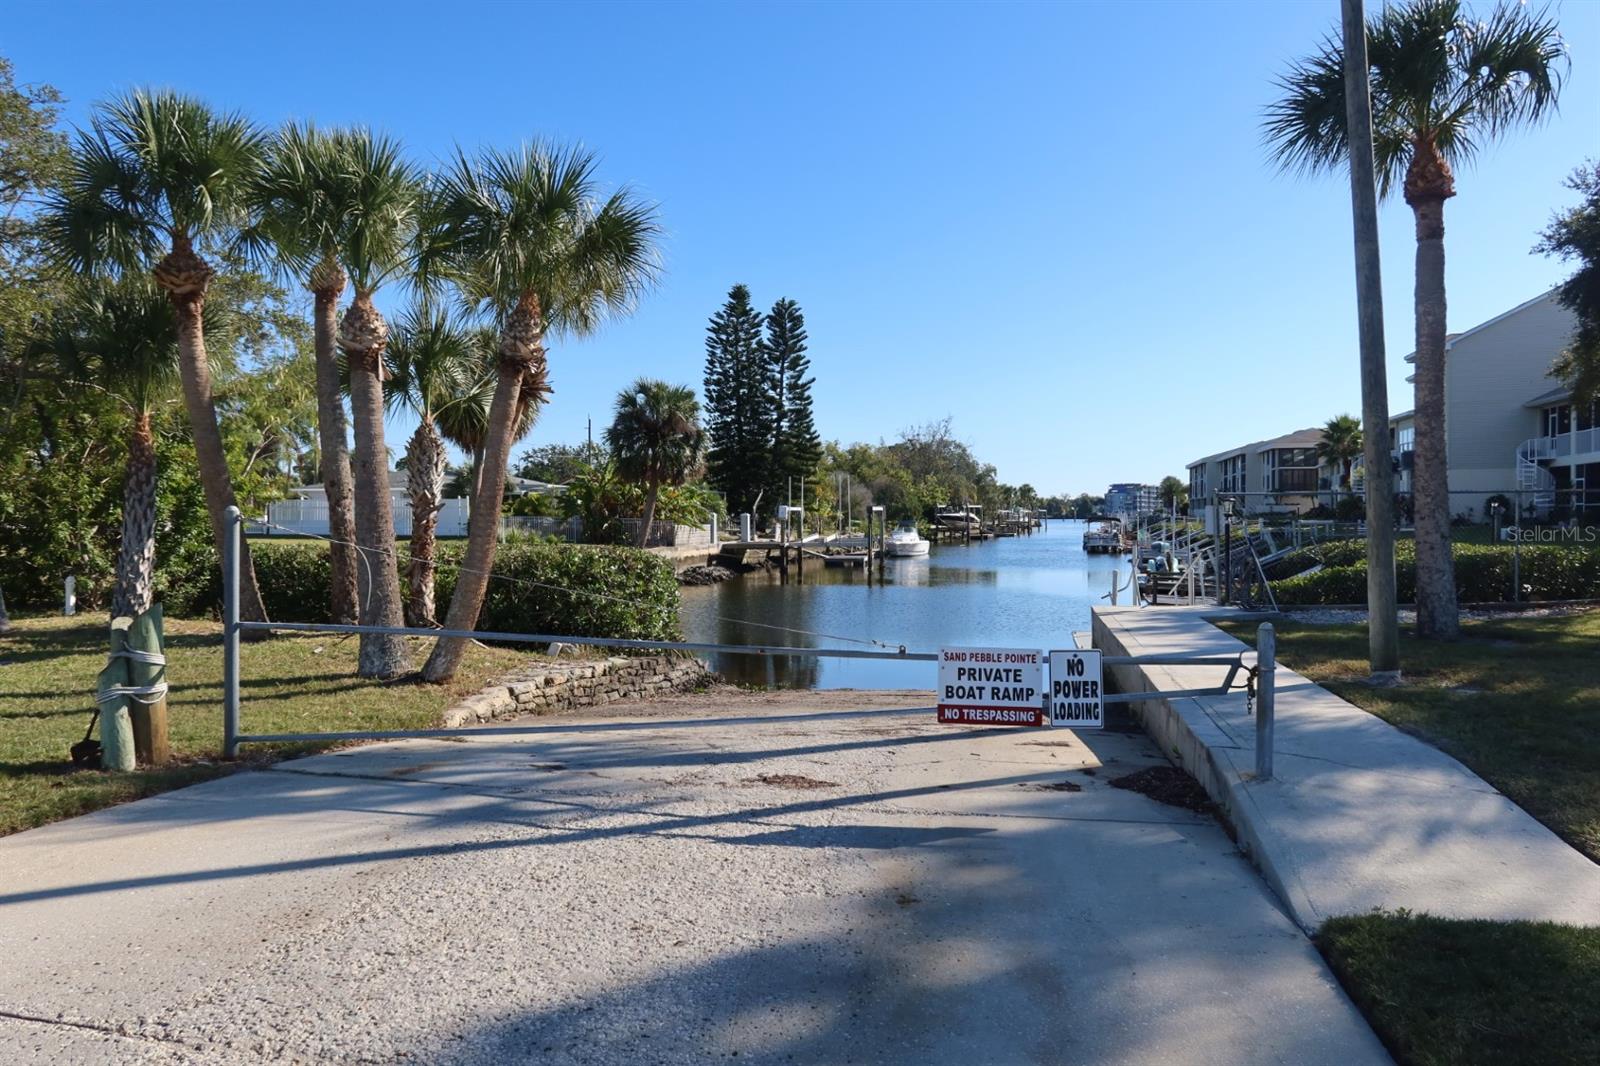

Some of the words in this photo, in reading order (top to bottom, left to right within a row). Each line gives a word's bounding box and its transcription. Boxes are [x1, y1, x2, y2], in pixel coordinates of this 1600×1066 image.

[944, 652, 967, 662] SAND
[970, 653, 1001, 663] PEBBLE
[1005, 653, 1037, 664] POINTE
[957, 667, 1022, 683] PRIVATE
[1067, 658, 1084, 676] NO
[945, 685, 985, 700] BOAT
[991, 687, 1035, 701] RAMP
[1054, 680, 1099, 699] POWER
[944, 708, 959, 719] NO
[963, 709, 1035, 722] TRESPASSING
[1054, 702, 1099, 720] LOADING
